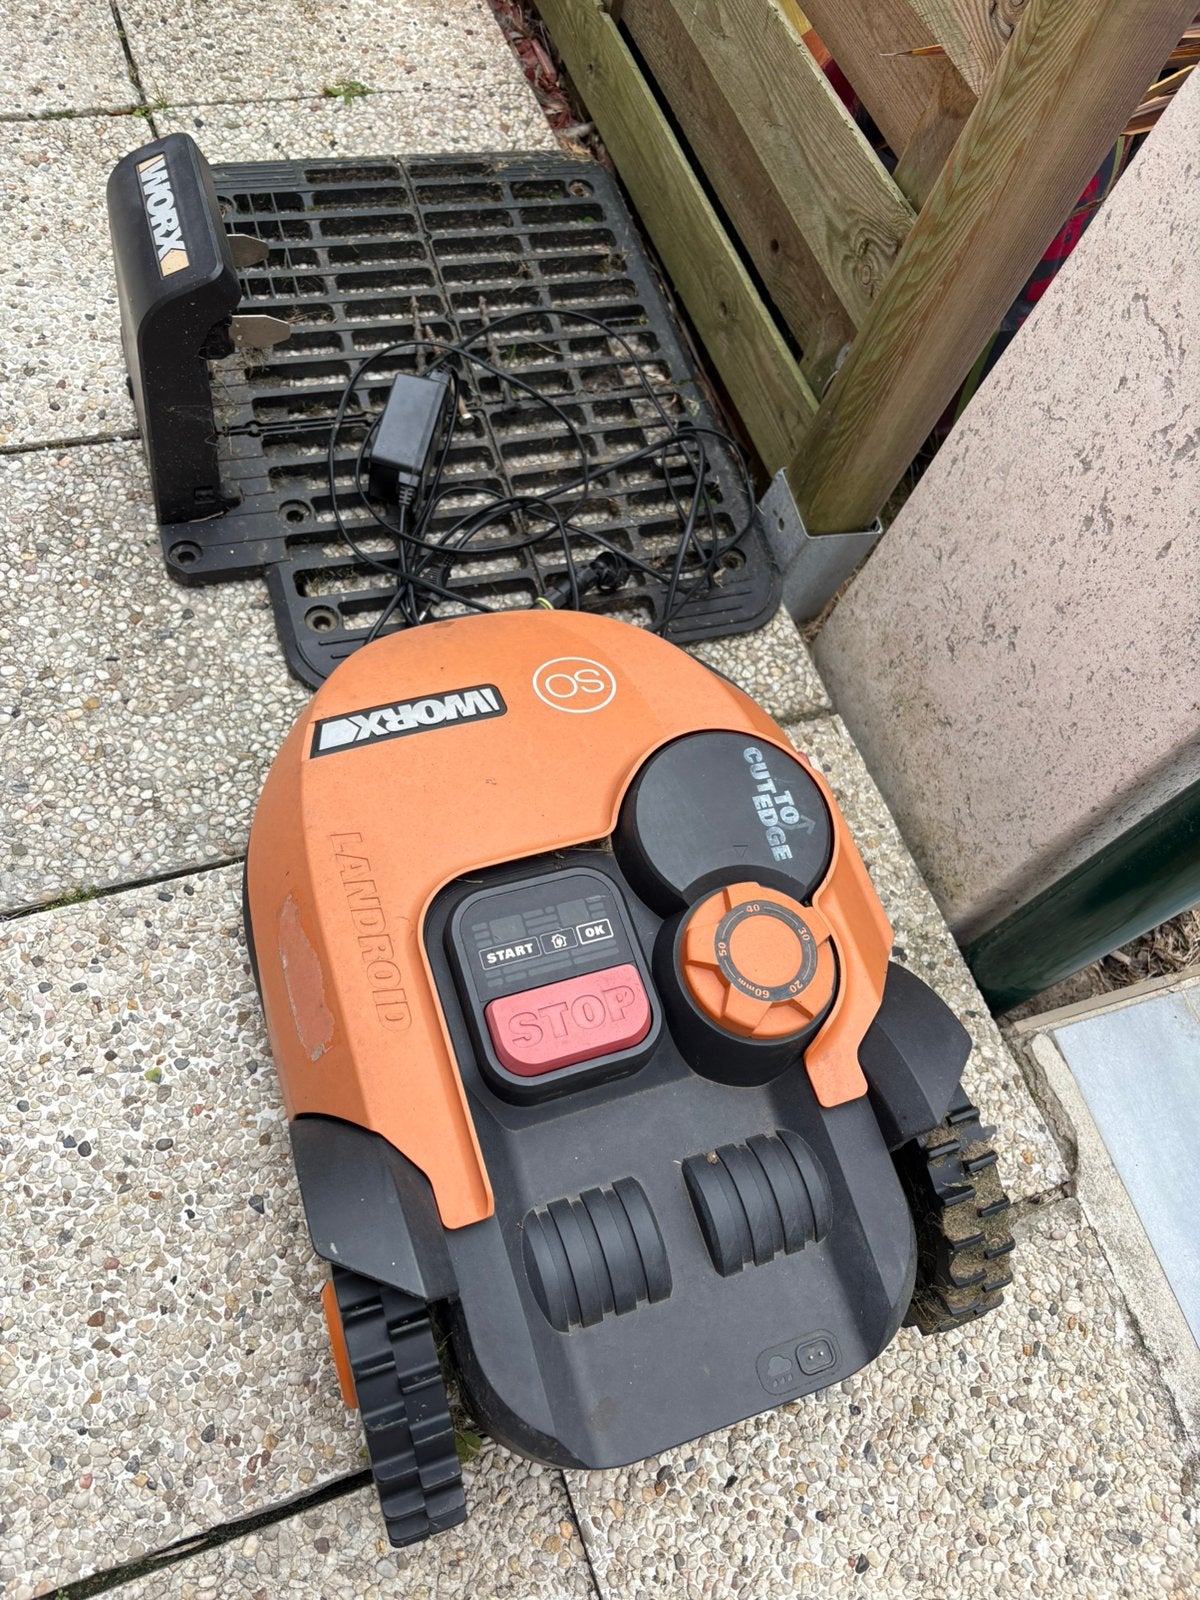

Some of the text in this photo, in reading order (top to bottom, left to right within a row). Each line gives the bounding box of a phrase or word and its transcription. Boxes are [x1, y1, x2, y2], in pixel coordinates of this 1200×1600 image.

[139, 157, 186, 261] WORX
[349, 691, 493, 741] WORX
[746, 904, 760, 913] 40
[330, 832, 412, 1032] LANDROID
[585, 924, 606, 938] OK
[798, 926, 811, 941] 30
[486, 943, 533, 964] START
[718, 942, 728, 957] 50
[789, 980, 804, 994] 20
[508, 985, 636, 1048] STOP
